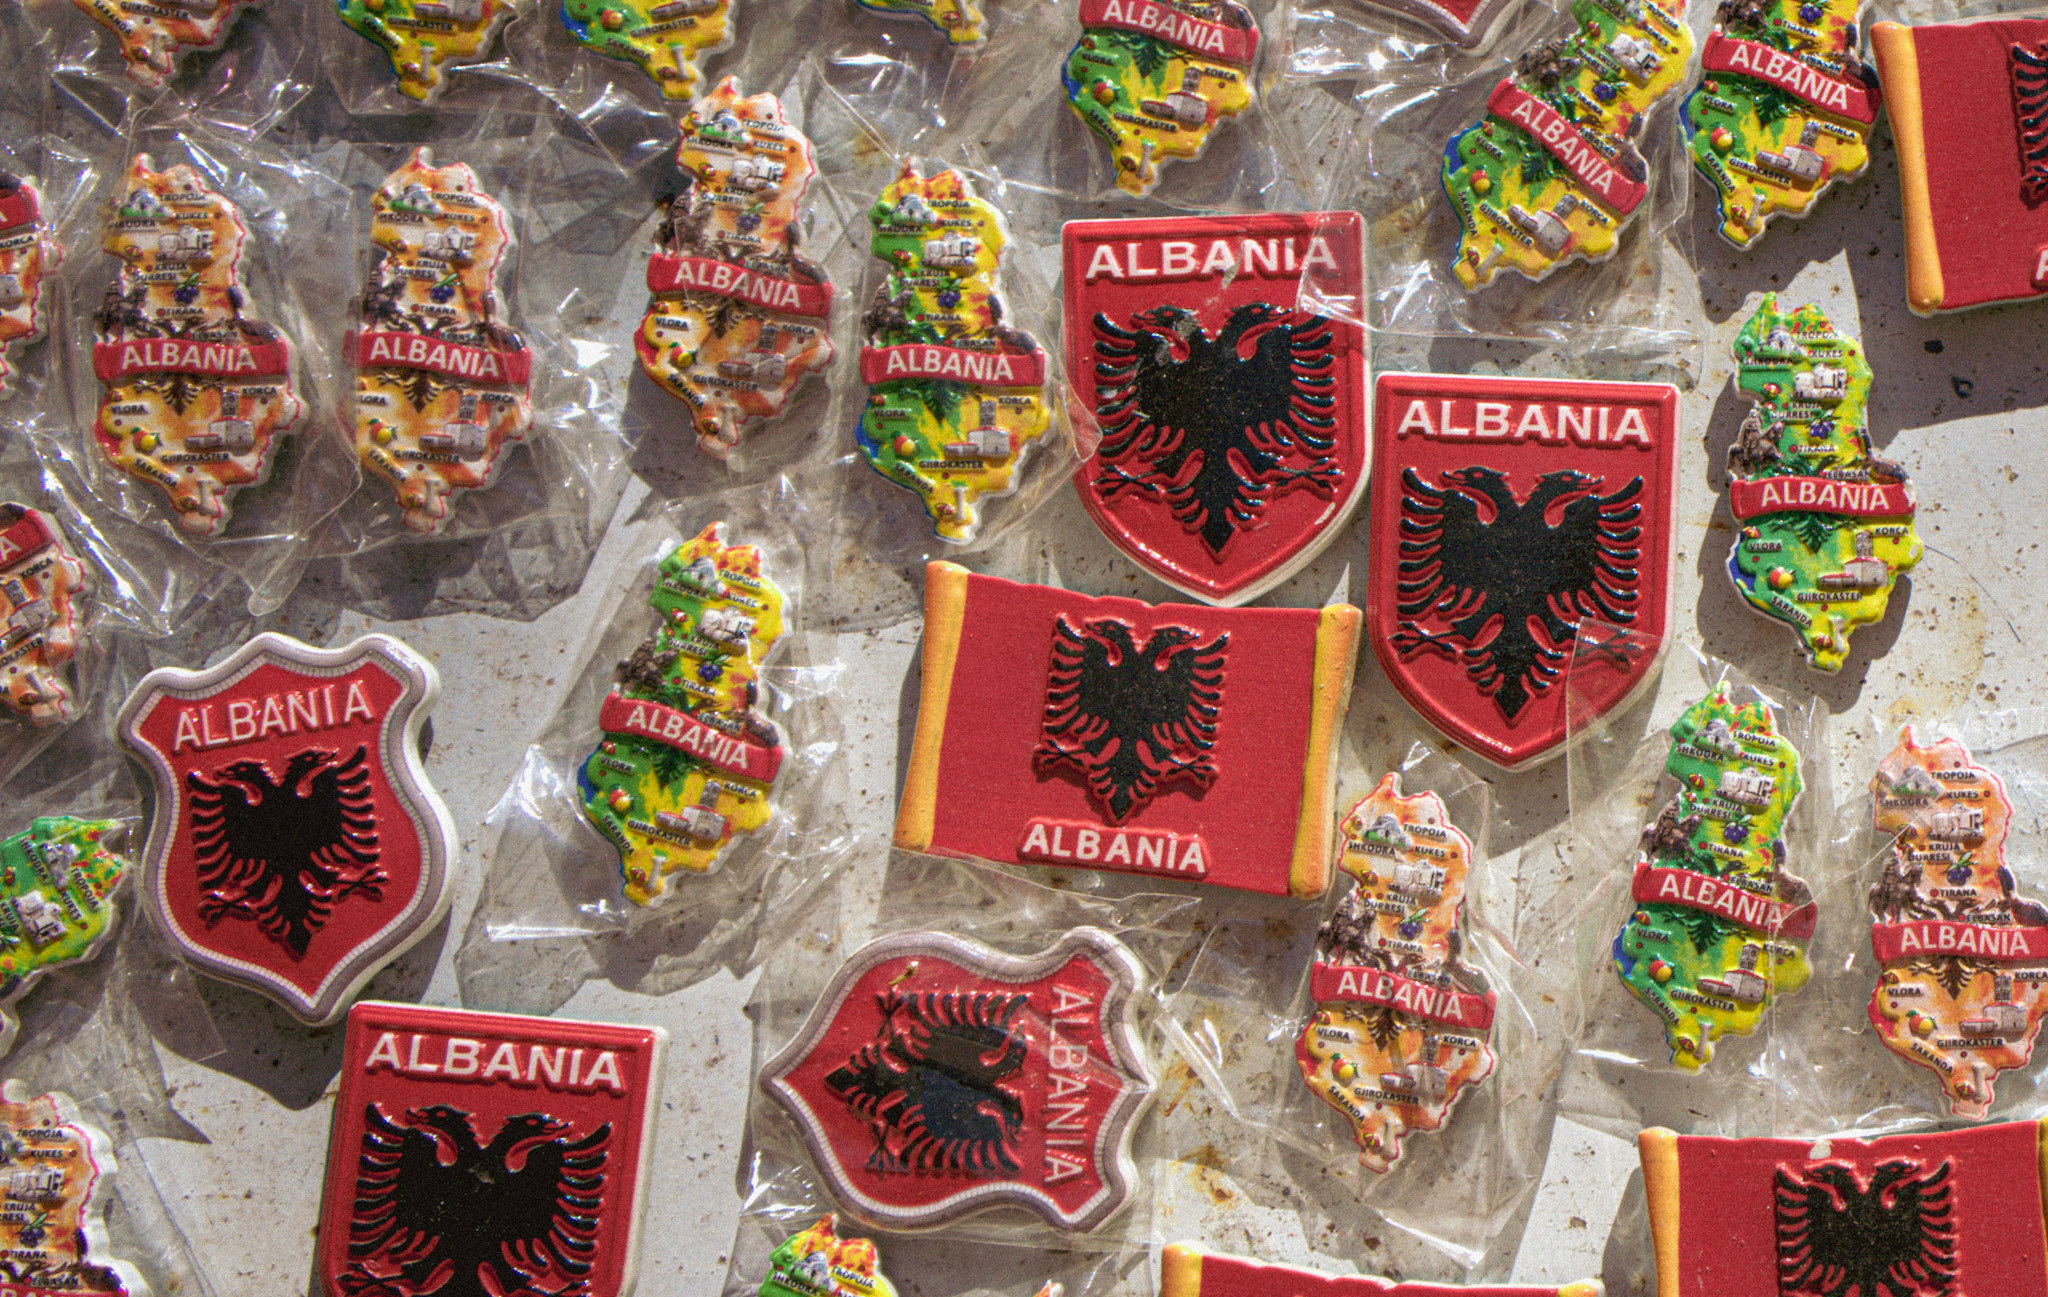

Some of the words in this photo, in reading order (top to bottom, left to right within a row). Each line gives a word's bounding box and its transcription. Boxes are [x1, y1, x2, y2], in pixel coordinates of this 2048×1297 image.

[1103, 0, 1224, 53] ALBANIA
[1205, 67, 1236, 81] KORCA
[1729, 44, 1848, 110] ALBANIA
[1704, 95, 1734, 111] VLORA
[1825, 124, 1856, 139] KORCA
[1476, 135, 1503, 159] VLORA
[1511, 99, 1614, 195] ALBANIA
[1704, 152, 1735, 193] SARANDA
[1729, 158, 1791, 185] GJIROKASTER
[444, 213, 475, 222] KUKES
[1581, 199, 1610, 226] KORCA
[1479, 204, 1533, 247] GJIROKASTER
[1085, 238, 1338, 279] ALBANIA
[674, 261, 801, 308] ALBANIA
[655, 317, 688, 329] VLORA
[782, 324, 815, 336] KORCA
[122, 343, 257, 371] ALBANIA
[370, 337, 499, 377] ALBANIA
[886, 349, 1014, 380] ALBANIA
[668, 373, 704, 409] SARANDA
[693, 375, 758, 391] GJIROKASTER
[242, 388, 277, 396] KORCA
[360, 396, 387, 404] LORA
[481, 393, 514, 403] KORCA
[111, 405, 145, 413] VLORA
[1398, 400, 1652, 444] ALBANIA
[135, 459, 178, 489] SARANDA
[1761, 481, 1889, 511] ALBANIA
[1875, 526, 1909, 535] KORCA
[1750, 542, 1782, 551] VLORA
[19, 557, 54, 579] KORCA
[1797, 593, 1863, 602] GJIROKASTER
[1772, 596, 1813, 627] SARANDA
[174, 681, 374, 751] ALBANIA
[626, 705, 748, 769] ALBANIA
[1732, 730, 1776, 748] TROPOJA
[1676, 744, 1724, 762] SHKODRA
[1742, 754, 1774, 767] KUKES
[601, 756, 633, 773] VLORA
[1931, 771, 1976, 780] TROPOJA
[724, 782, 757, 798] KORCA
[1689, 803, 1731, 819] DURRESI
[1712, 799, 1743, 812] KRUJA
[1879, 799, 1929, 807] SHKODRA
[602, 814, 635, 855] SARANDA
[628, 819, 691, 846] GJIROKASTER
[1403, 823, 1447, 839] TROPOJA
[1022, 823, 1205, 873] ALBANIA
[1348, 840, 1396, 856] SHKODRA
[1415, 845, 1445, 858] KUKES
[1708, 844, 1744, 859] TIRANA
[1929, 843, 1960, 852] KRUJA
[1907, 853, 1951, 862] DURRESI
[71, 867, 100, 909] TROPOJA
[1940, 889, 1977, 897] TIRANA
[61, 891, 82, 921] KUKES
[1364, 899, 1405, 913] DURRESI
[1386, 894, 1417, 906] KRUJA
[1659, 874, 1784, 929] ALBANIA
[1967, 914, 2011, 922] ELBASAN
[1636, 928, 1669, 943] VLORA
[1900, 925, 2030, 956] ALBANIA
[1388, 940, 1424, 952] TIRANA
[2015, 971, 2048, 980] KORCA
[1337, 971, 1463, 1020] ALBANIA
[1888, 988, 1921, 996] VLORA
[1644, 987, 1680, 1026] SARANDA
[1670, 989, 1735, 1012] GJIROKASTER
[1317, 1028, 1350, 1040] VLORA
[1444, 1035, 1476, 1047] KORCA
[1937, 1039, 2003, 1048] GJIROKASTER
[365, 1032, 622, 1088] ALBANIA
[1911, 1043, 1953, 1074] SARANDA
[1044, 986, 1093, 1182] ALBANIA
[1355, 1087, 1419, 1105] GJIROKASTER
[1328, 1086, 1365, 1123] SARANDA
[17, 1129, 63, 1138] TROPOJA
[31, 1150, 63, 1158] KUKES
[5, 1203, 36, 1211] KRUJA
[832, 1266, 873, 1289] TROPOJA
